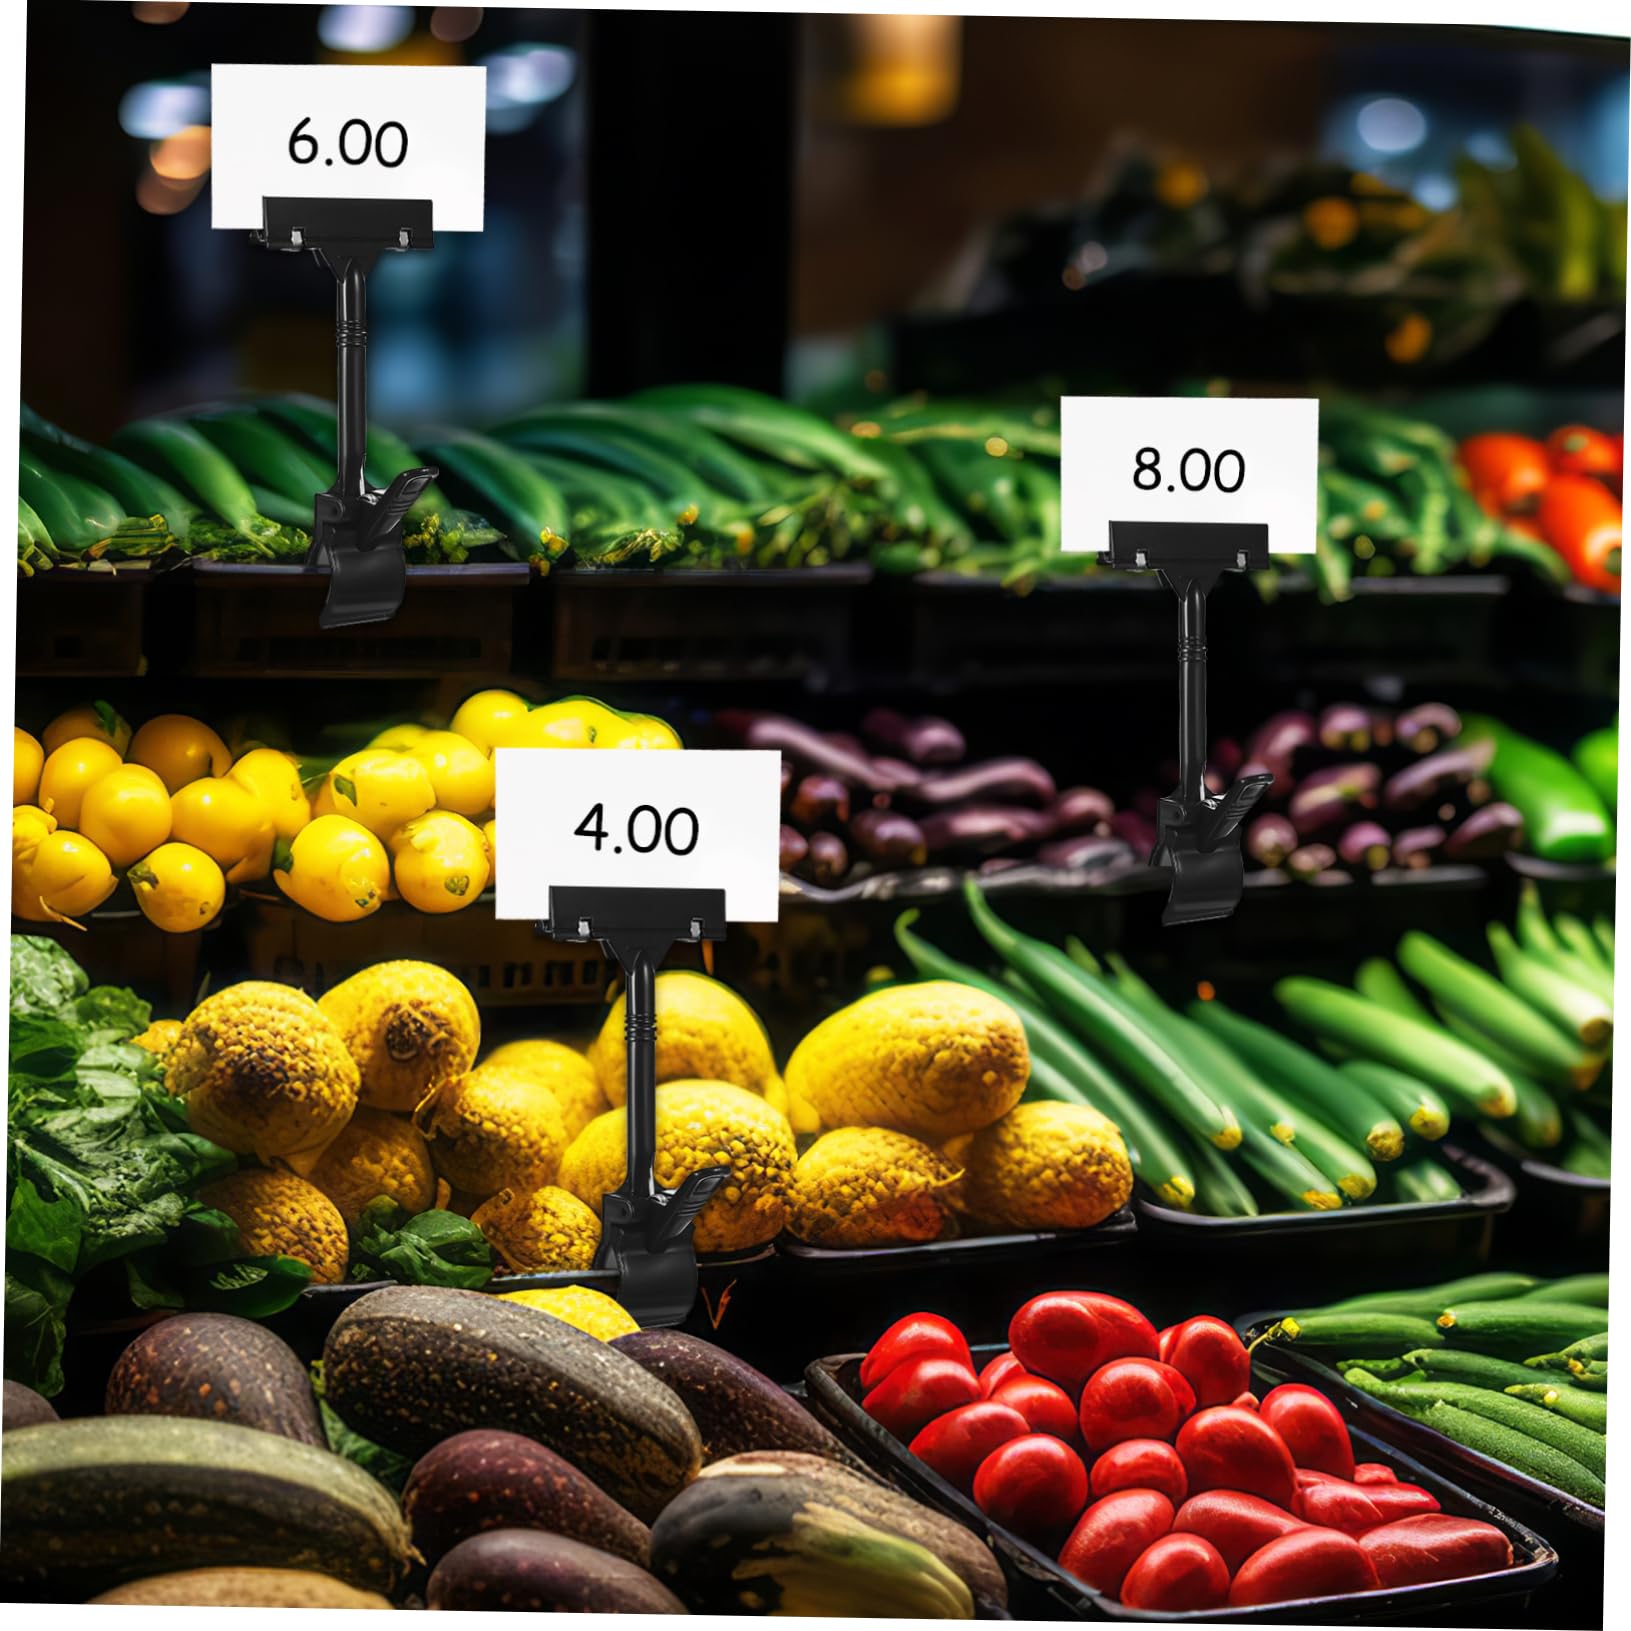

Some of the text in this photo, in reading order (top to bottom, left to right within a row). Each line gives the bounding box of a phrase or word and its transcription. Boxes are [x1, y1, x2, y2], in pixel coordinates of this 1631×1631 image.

[288, 116, 409, 169] 6.00
[1133, 446, 1246, 494] 8.00
[573, 802, 699, 856] 4.00
